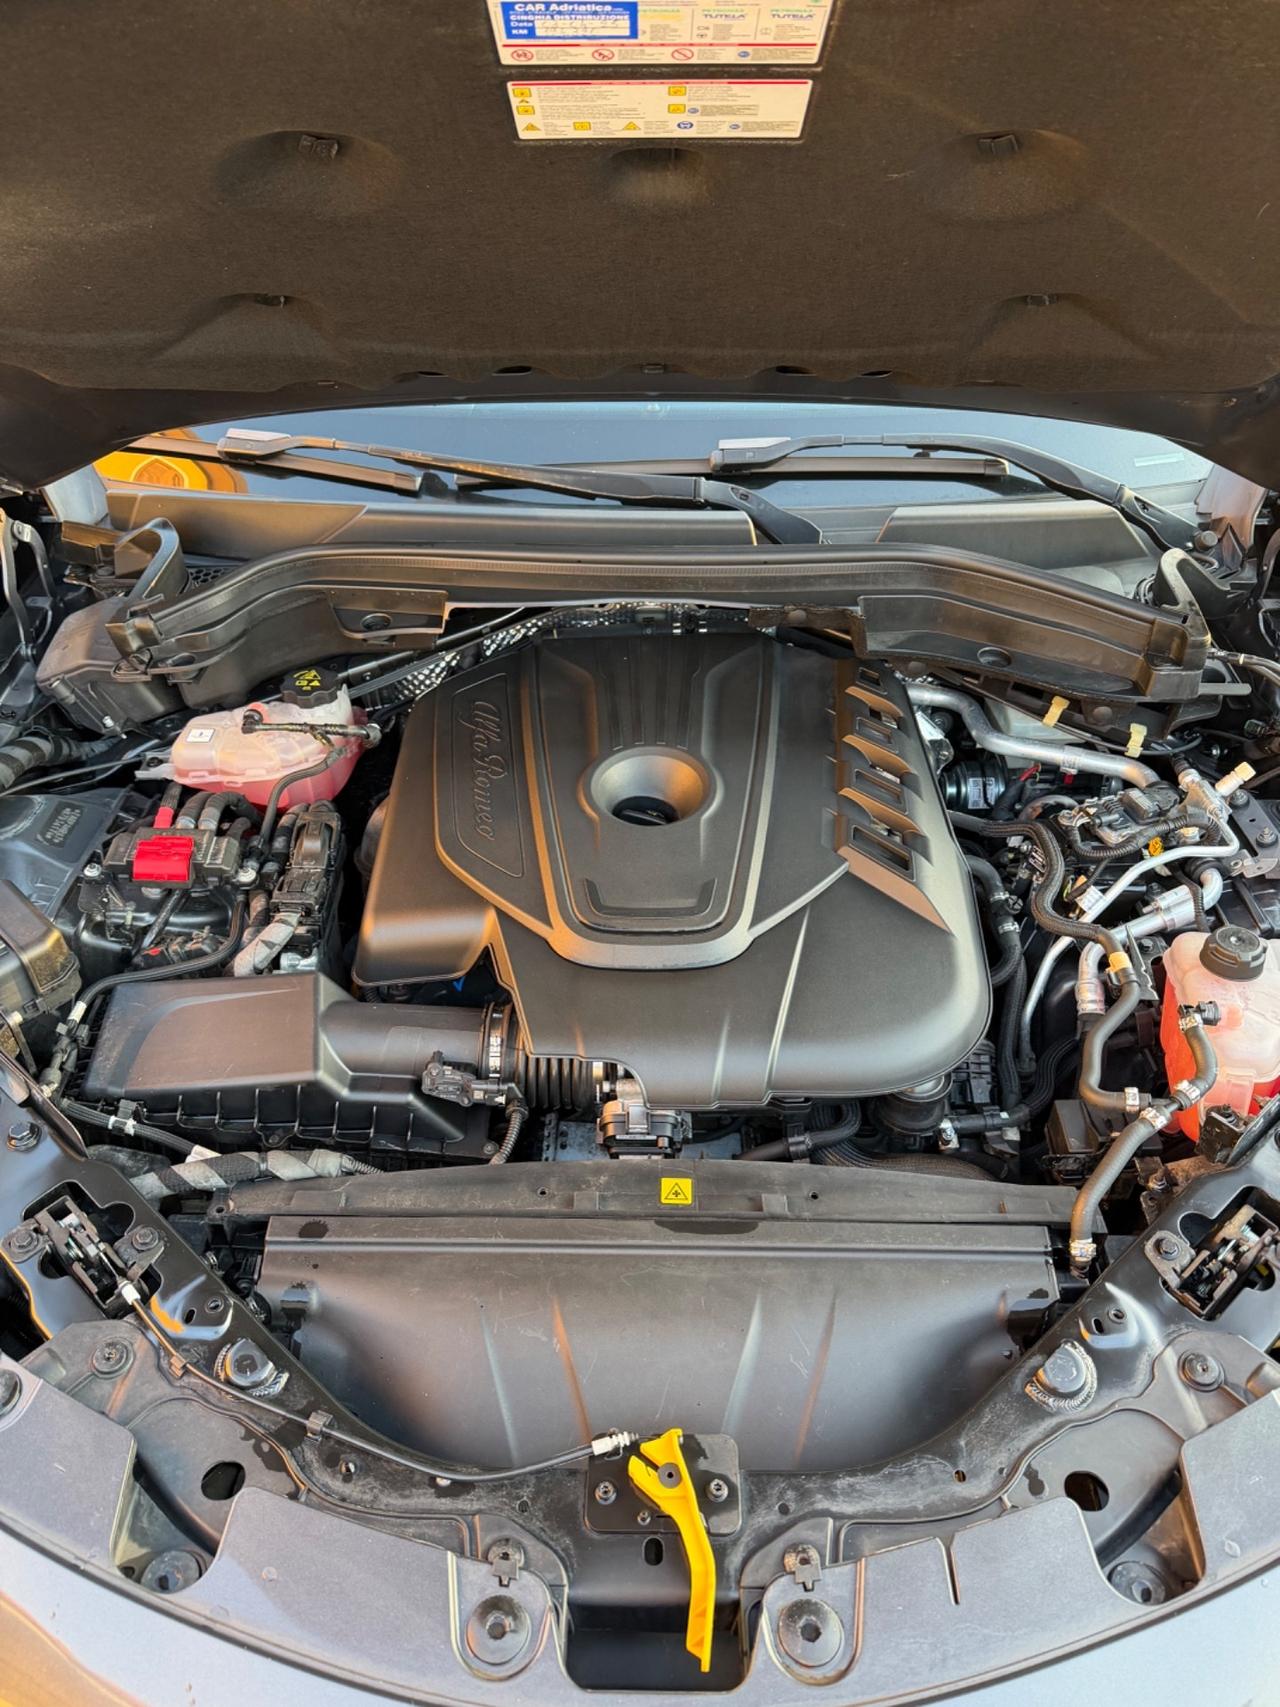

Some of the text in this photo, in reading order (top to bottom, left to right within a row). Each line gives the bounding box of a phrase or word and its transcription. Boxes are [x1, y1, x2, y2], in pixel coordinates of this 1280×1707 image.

[514, 3, 546, 12] CAR
[549, 3, 612, 12] Adriatica
[458, 701, 508, 841] Alfa Romeo
